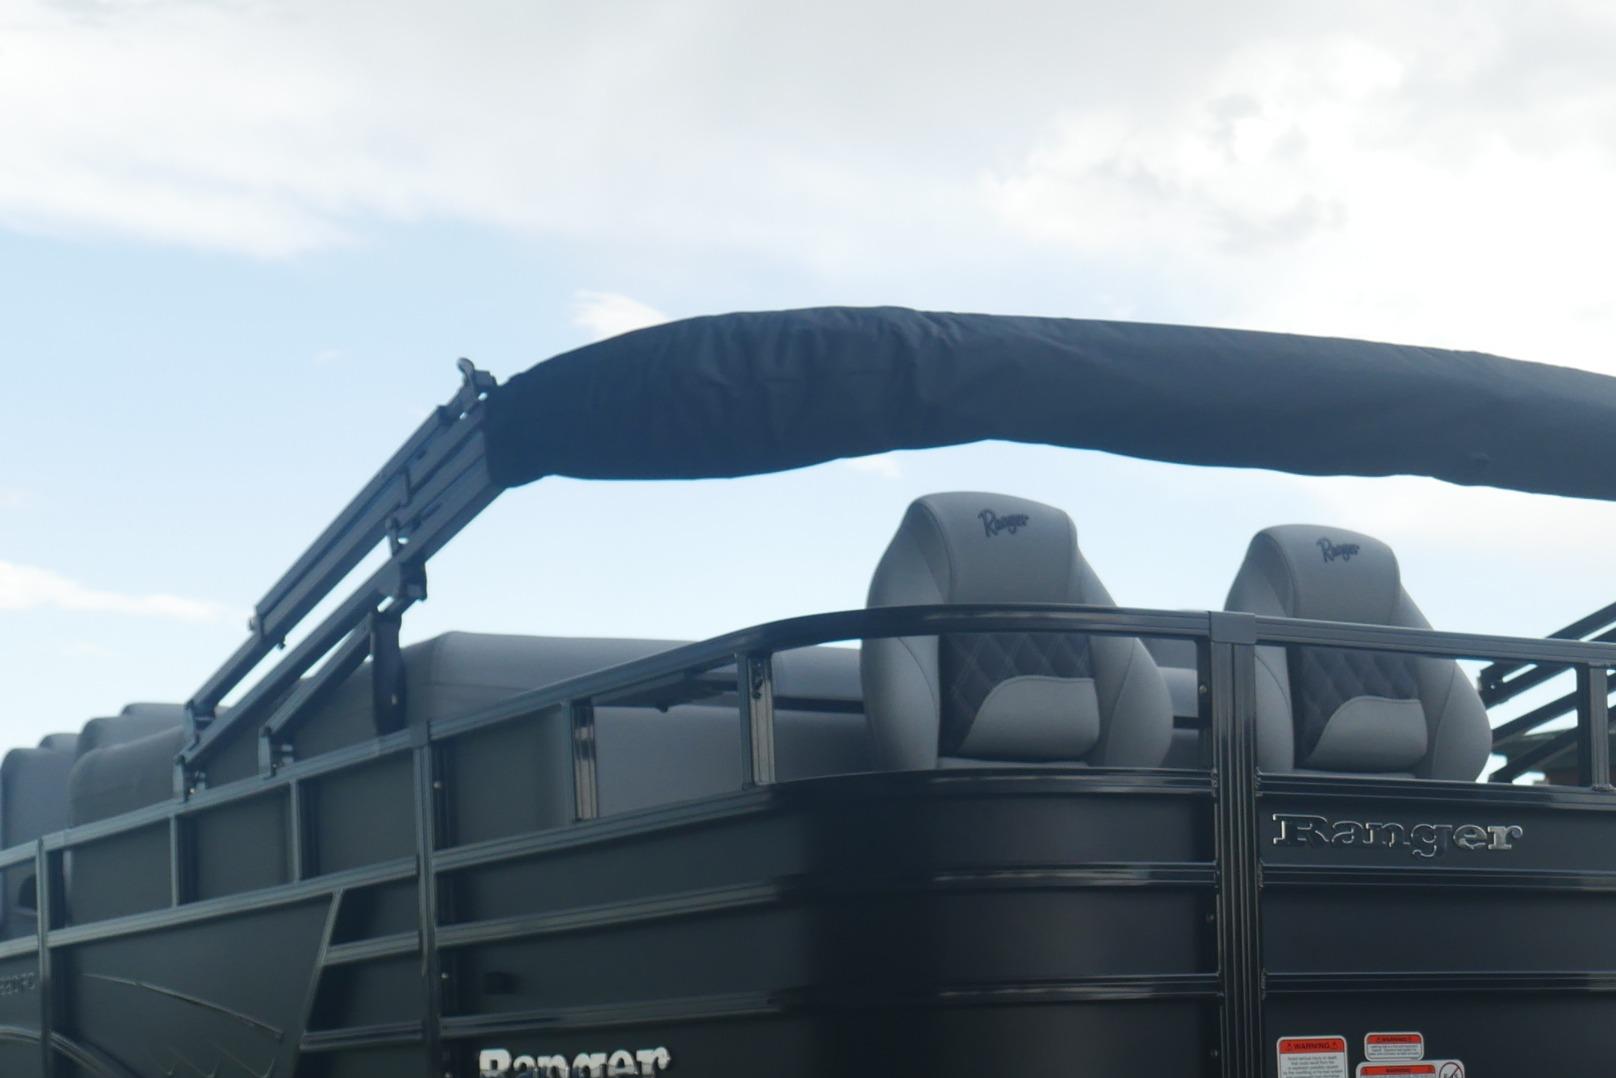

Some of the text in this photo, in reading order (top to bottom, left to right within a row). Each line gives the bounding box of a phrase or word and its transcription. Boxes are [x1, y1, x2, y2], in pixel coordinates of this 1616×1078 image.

[977, 508, 1030, 539] Ranger
[1316, 538, 1361, 563] Ranger
[1271, 812, 1524, 858] Ranger
[1293, 1042, 1330, 1050] WARNING
